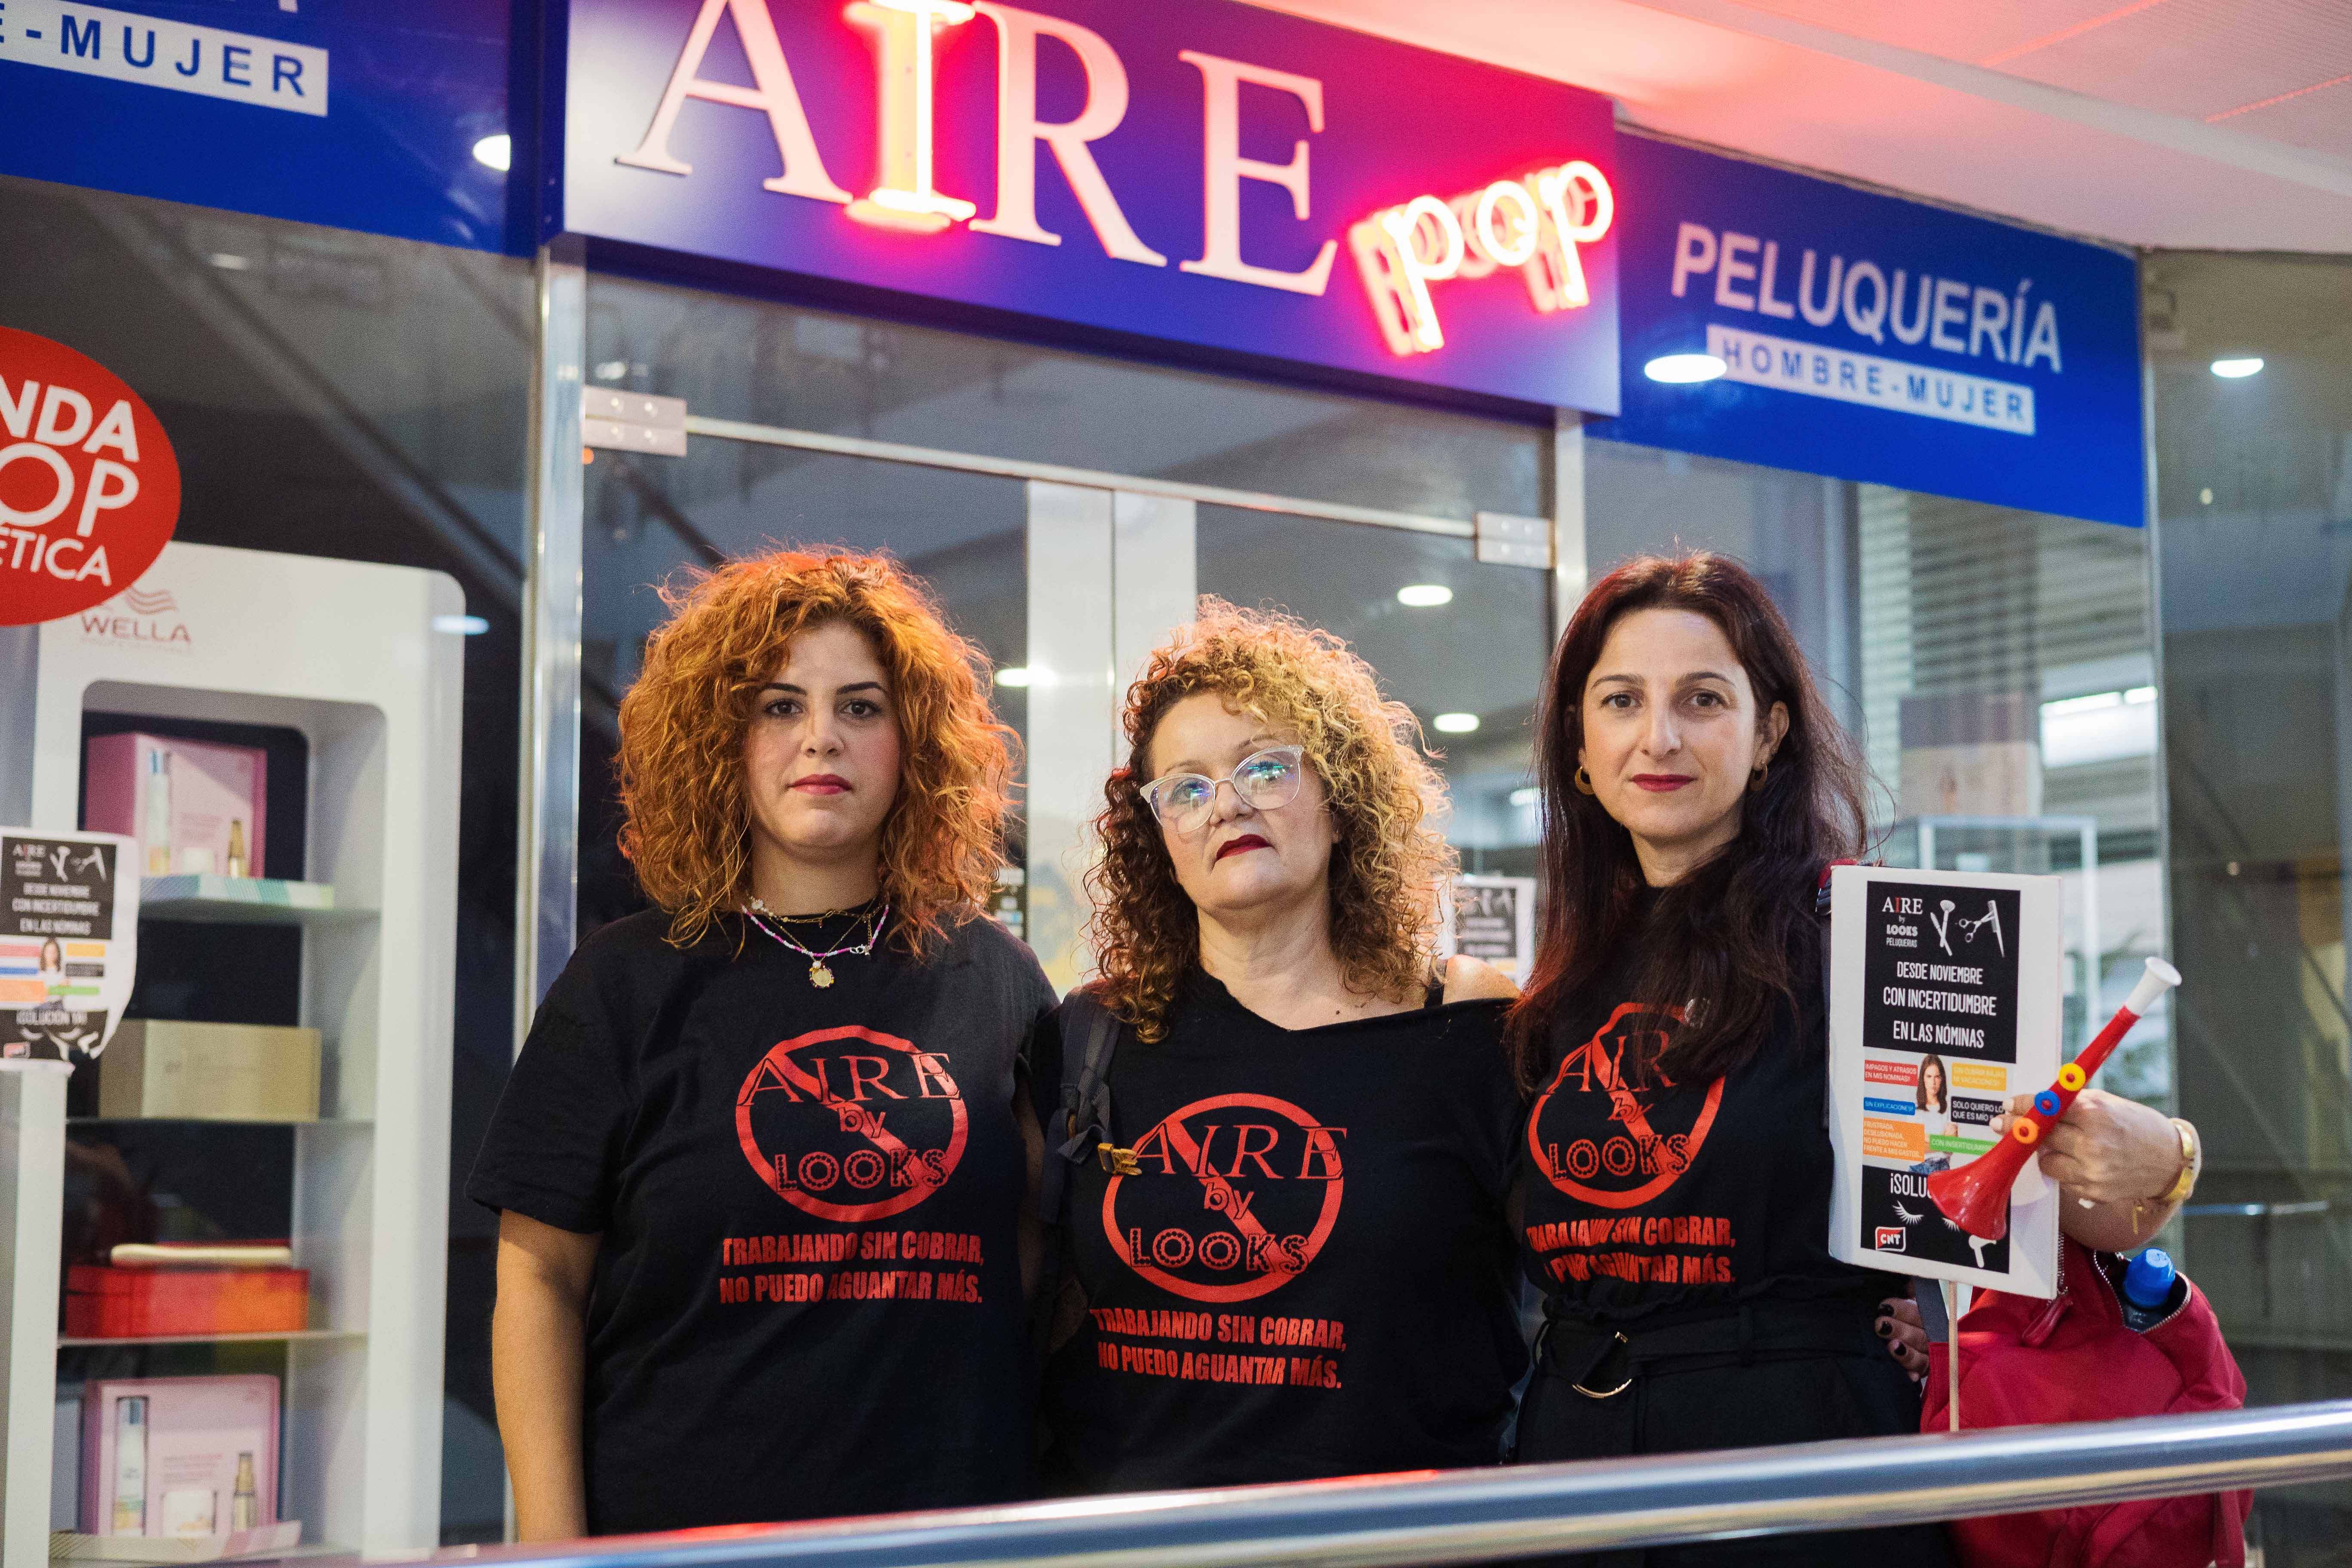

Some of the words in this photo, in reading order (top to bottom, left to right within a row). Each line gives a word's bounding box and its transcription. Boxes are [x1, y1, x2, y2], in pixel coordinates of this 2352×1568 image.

[0, 2, 305, 97] -MUJER
[612, 0, 1338, 297] AIRE
[1354, 160, 1614, 353] pop
[1671, 222, 2062, 374] PELUQUERÍA
[1721, 336, 2024, 422] HOMBRE-MUJER
[81, 614, 192, 644] WELLA
[1882, 897, 1923, 916] AIRE
[1899, 916, 1905, 924] by
[1886, 924, 1918, 937] LOOKS
[1897, 961, 1928, 980] DESDE
[1929, 965, 1983, 985] NOVIEMBRE
[1883, 986, 1905, 1007] CON
[1908, 989, 1997, 1016] INCERTIDUMBRE
[1893, 1020, 1908, 1040] EN
[1911, 1023, 1933, 1043] LAS
[1936, 1023, 1985, 1048] NÓMINAS
[736, 1052, 962, 1106] AIRE
[1545, 1029, 1678, 1095] AIR
[837, 1106, 886, 1138] by
[1952, 1100, 1969, 1110] SOLO
[1970, 1102, 1994, 1112] QUIERO
[1952, 1110, 1965, 1119] QUE
[1976, 1112, 1989, 1121] MÍO
[1133, 1122, 1348, 1180] AIRE
[1548, 1133, 1692, 1181] LOOKS
[774, 1148, 949, 1192] LOOKS
[1204, 1182, 1254, 1219] by
[723, 1232, 858, 1266] TRABAJANDO
[861, 1231, 897, 1259] SIN
[901, 1231, 984, 1265] COBRAR,
[1644, 1215, 1736, 1248] COBRAR,
[1880, 1234, 1902, 1246] CNT
[1130, 1228, 1309, 1273] LOOKS
[720, 1277, 750, 1304] NO
[754, 1274, 824, 1303] PUEDO
[827, 1271, 933, 1301] AGUANTAR
[936, 1269, 983, 1303] MÁS.
[1682, 1253, 1736, 1285] MÁS.
[1090, 1308, 1212, 1341] TRABAJANDO
[1217, 1314, 1255, 1344] SIN
[1260, 1317, 1346, 1351] COBRAR,
[1098, 1341, 1118, 1370] NO
[1121, 1345, 1178, 1378] PUEDO
[1181, 1352, 1286, 1385] AGUANTAR
[1290, 1355, 1341, 1389] MÁS.
